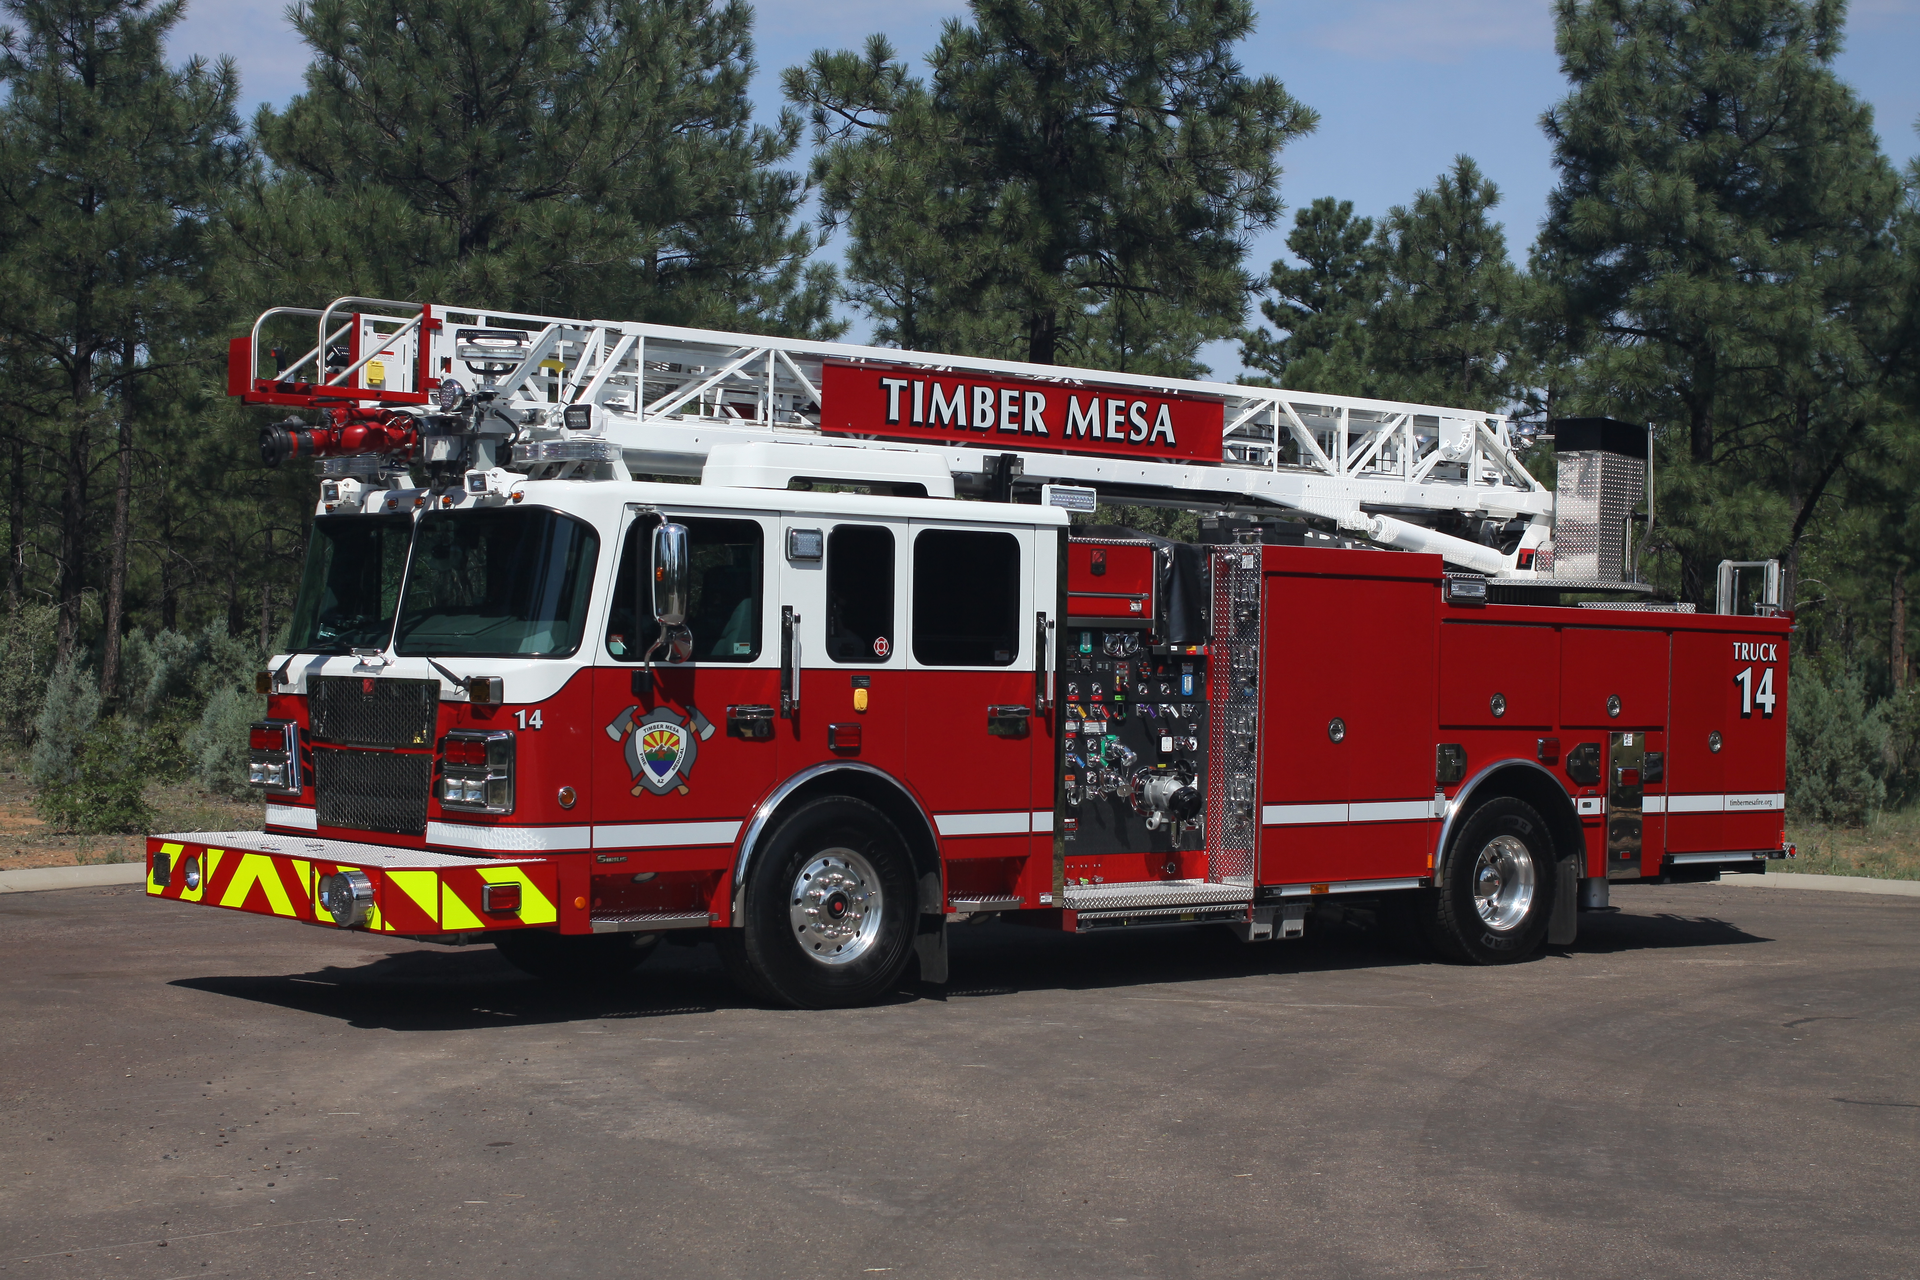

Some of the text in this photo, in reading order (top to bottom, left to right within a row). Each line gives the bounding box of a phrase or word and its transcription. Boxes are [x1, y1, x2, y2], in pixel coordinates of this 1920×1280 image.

[881, 377, 1178, 447] TIMBER MESA
[1733, 642, 1778, 662] TRUCK
[1733, 666, 1777, 719] 14
[512, 709, 544, 731] 14
[643, 723, 679, 733] TIMBER MESA
[639, 753, 647, 766] FIRE
[671, 747, 685, 771] MEDICAL
[1729, 798, 1773, 807] timbermesafire.org
